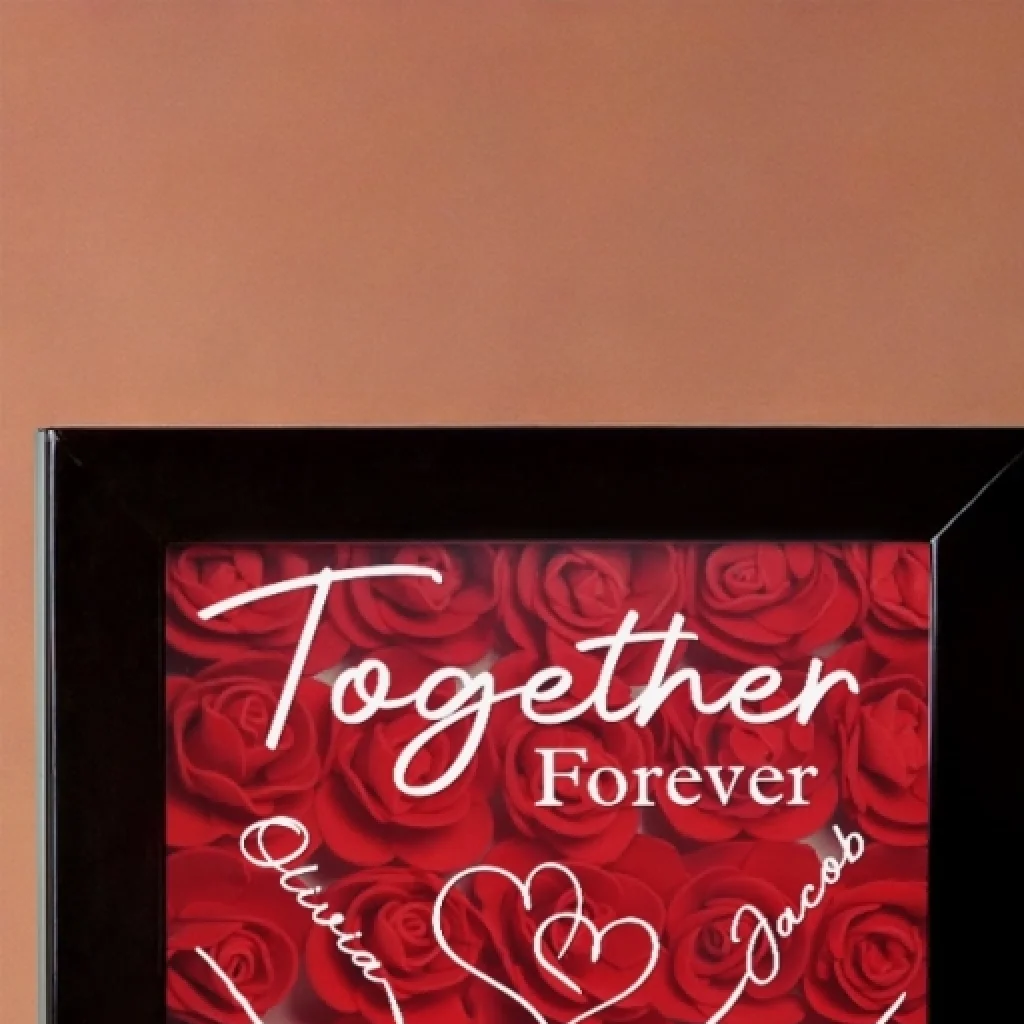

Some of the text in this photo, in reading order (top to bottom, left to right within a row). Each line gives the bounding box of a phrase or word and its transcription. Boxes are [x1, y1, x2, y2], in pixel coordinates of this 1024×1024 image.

[197, 563, 860, 798] Together
[535, 746, 820, 807] Forever
[239, 815, 386, 984] Olivia
[731, 825, 866, 986] Jacob
